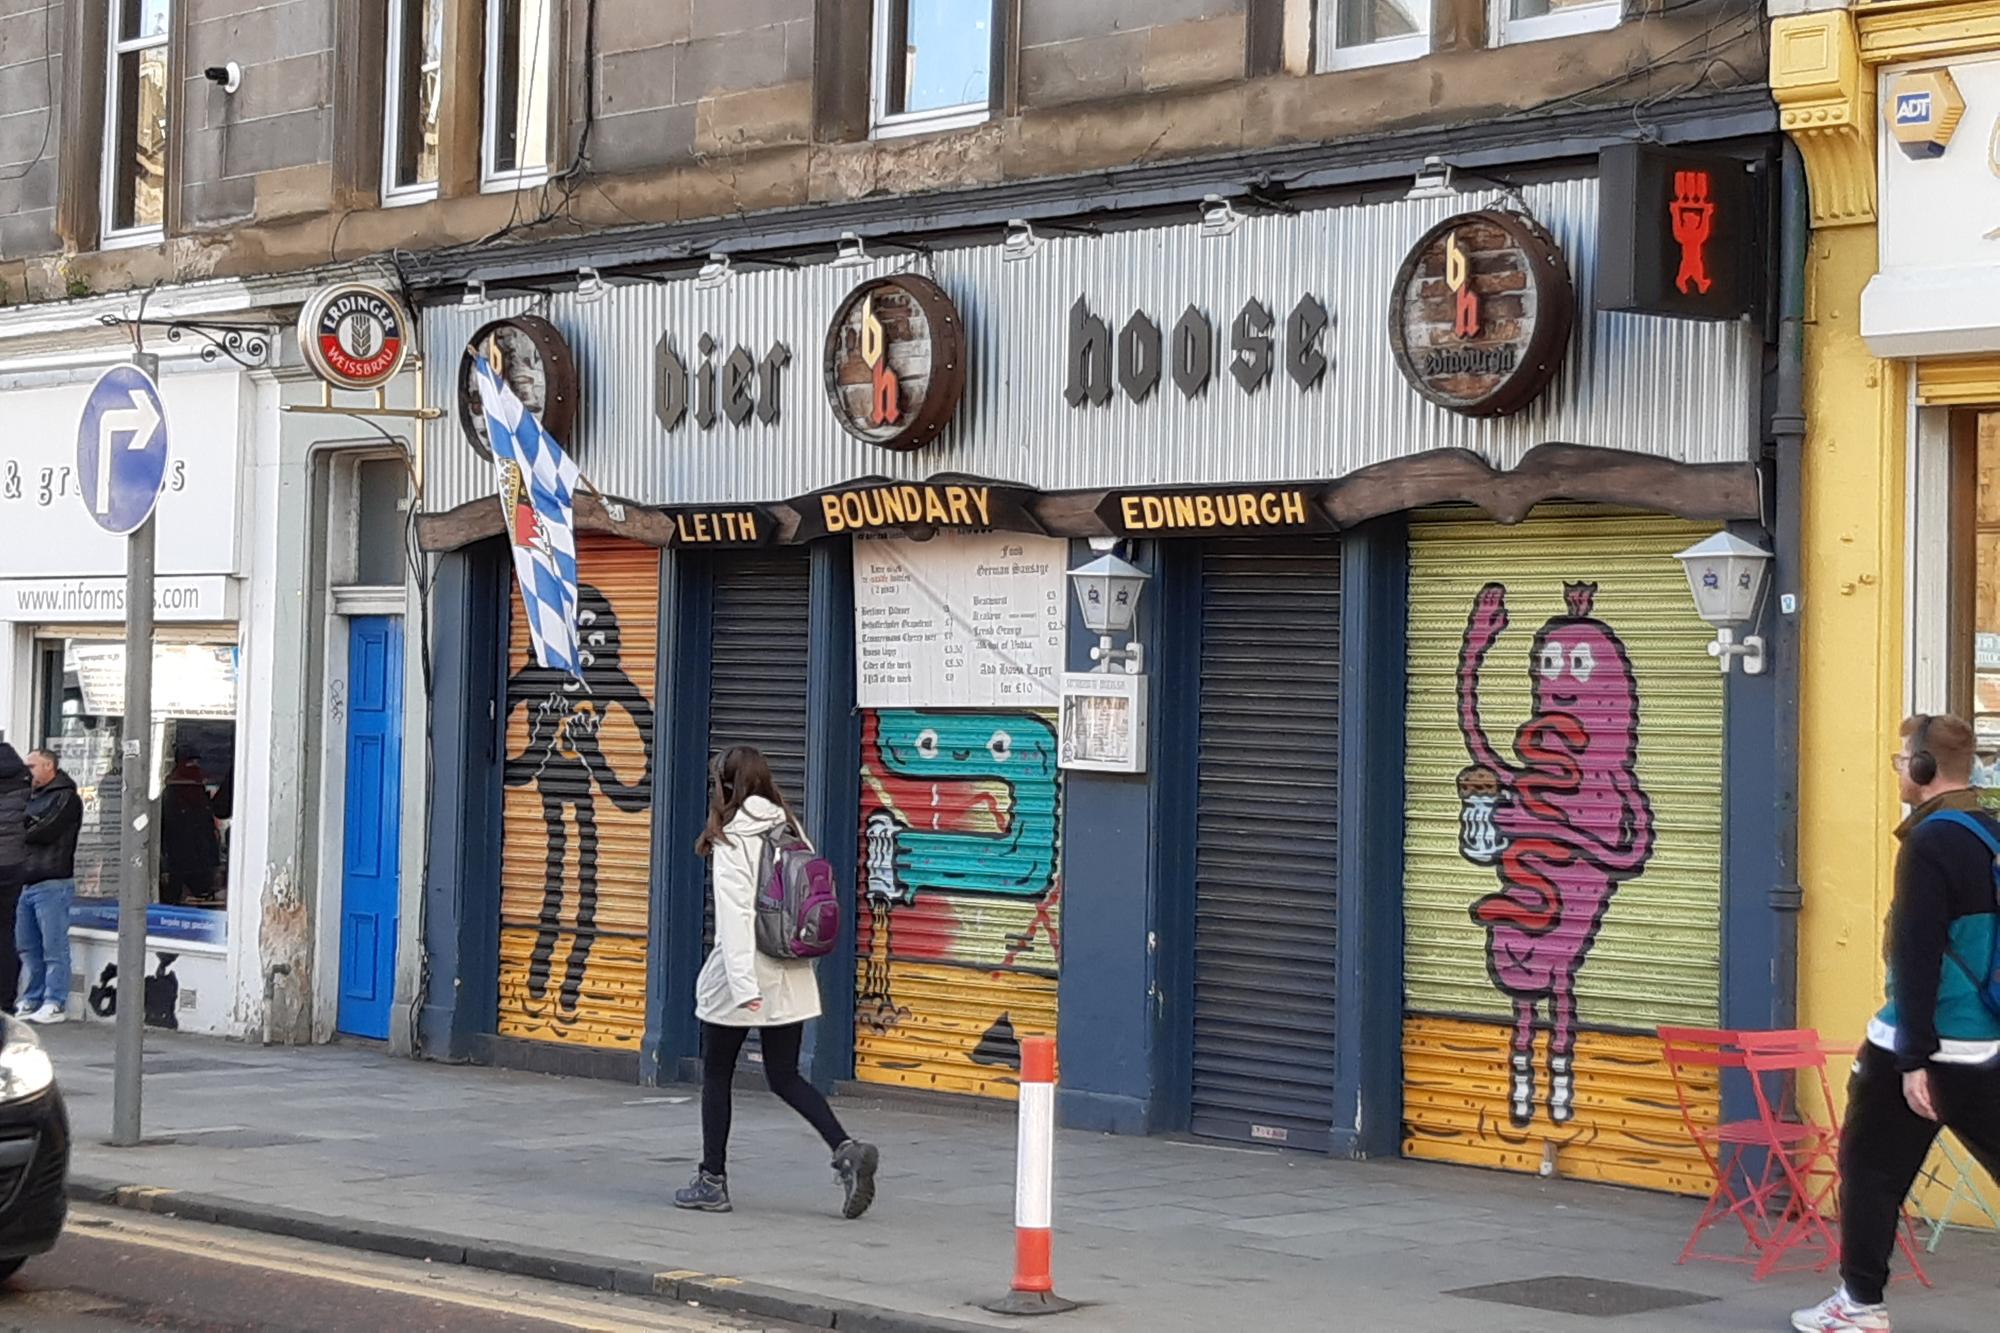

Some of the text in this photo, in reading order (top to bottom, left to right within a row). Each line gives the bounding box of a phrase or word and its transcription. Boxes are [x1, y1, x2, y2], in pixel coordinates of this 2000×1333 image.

[1895, 97, 1930, 121] ADT
[323, 296, 395, 331] ERDINGER
[654, 291, 1329, 433] bier hoose
[677, 512, 757, 542] LEITH
[823, 486, 990, 533] BOUNDARY
[1121, 492, 1306, 529] EDINBURGH
